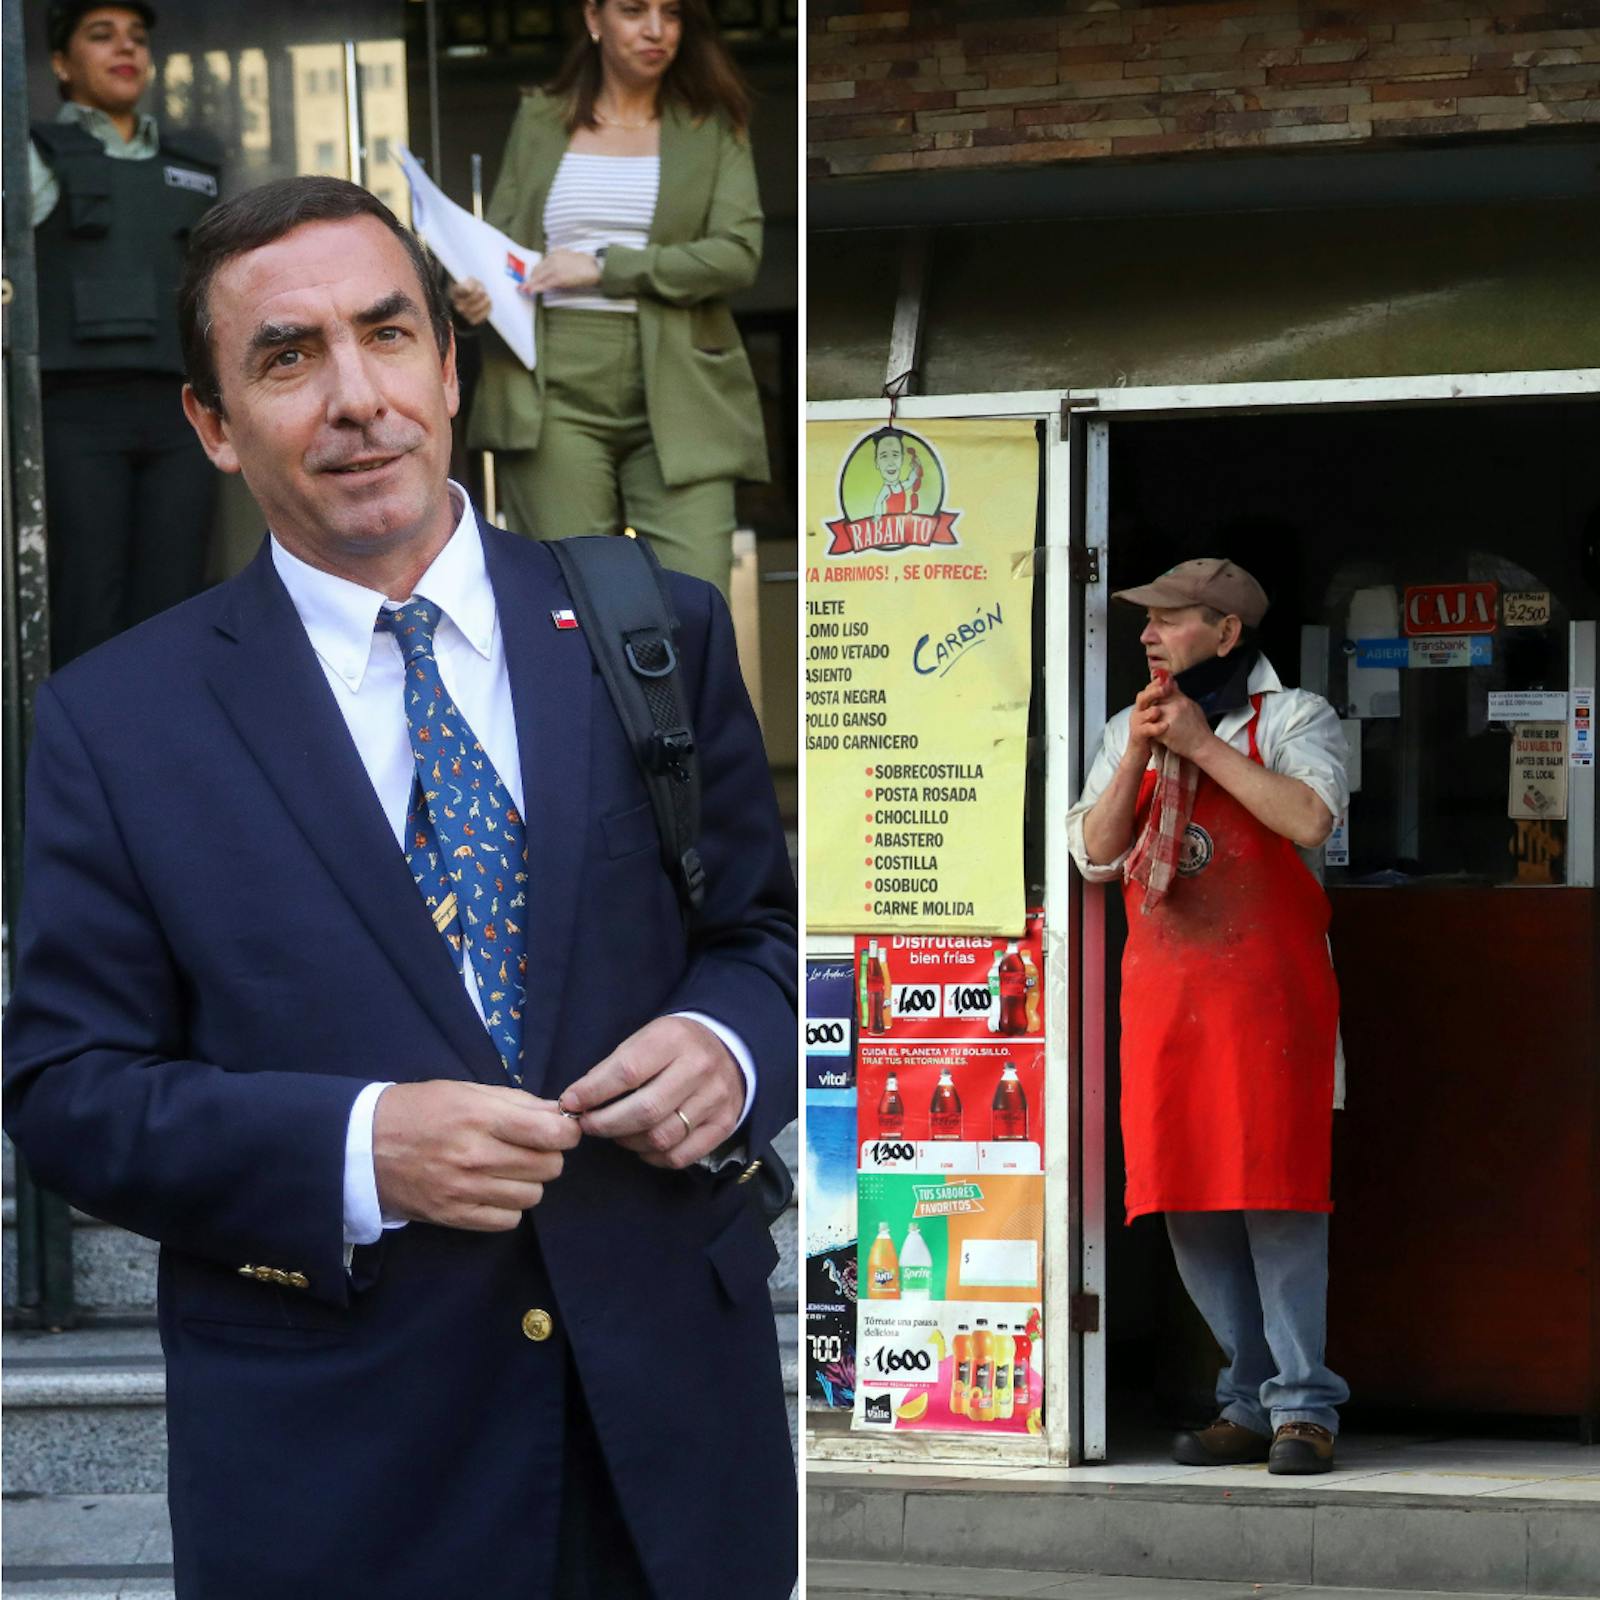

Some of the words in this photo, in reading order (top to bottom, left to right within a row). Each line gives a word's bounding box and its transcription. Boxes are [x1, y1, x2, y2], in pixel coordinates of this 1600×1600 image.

[824, 565, 889, 582] ABRIMOS!
[903, 565, 920, 580] SE
[924, 565, 987, 581] OFRECE:
[1410, 592, 1490, 625] CAJA
[806, 623, 839, 637] OMO
[842, 622, 868, 637] LISO
[913, 602, 1003, 674] CARBÓN
[1413, 639, 1467, 651] transbank
[806, 645, 838, 660] OMO
[842, 644, 889, 659] VETADO
[843, 690, 886, 704] NEGRA
[843, 712, 887, 727] GANSO
[806, 736, 839, 750] SADO
[843, 735, 918, 749] CARNICERO
[875, 765, 984, 779] SOBRECOSTILLA
[875, 787, 918, 801] POSTA
[923, 787, 977, 801] ROSADA
[875, 810, 948, 824] CHOCLILLO
[875, 833, 943, 847] ABASTERO
[875, 855, 938, 870] COSTILLA
[875, 878, 938, 892] OSOBUCO
[874, 901, 918, 915] CARNE
[923, 901, 974, 916] MOLIDA
[910, 951, 940, 964] bien
[943, 950, 976, 965] frías
[888, 1047, 898, 1056] EL
[901, 1047, 941, 1056] PLANETA
[942, 1047, 949, 1056] Y
[950, 1047, 960, 1056] TU
[962, 1047, 1011, 1056] BOLSILLO.
[862, 1057, 883, 1065] TRAE
[885, 1057, 902, 1065] TUS
[904, 1057, 968, 1065] RETORNABLES.
[818, 1071, 847, 1086] vital
[919, 1189, 935, 1201] TUS
[936, 1186, 975, 1199] SABORES
[920, 1200, 971, 1214] FAVORITOS
[864, 1316, 896, 1326] Tómate
[897, 1319, 912, 1327] una
[913, 1319, 938, 1328] pausa
[864, 1327, 899, 1337] deliciosa
[864, 1356, 871, 1367] $
[873, 1345, 931, 1375] 1,600
[867, 1409, 890, 1419] Valle
